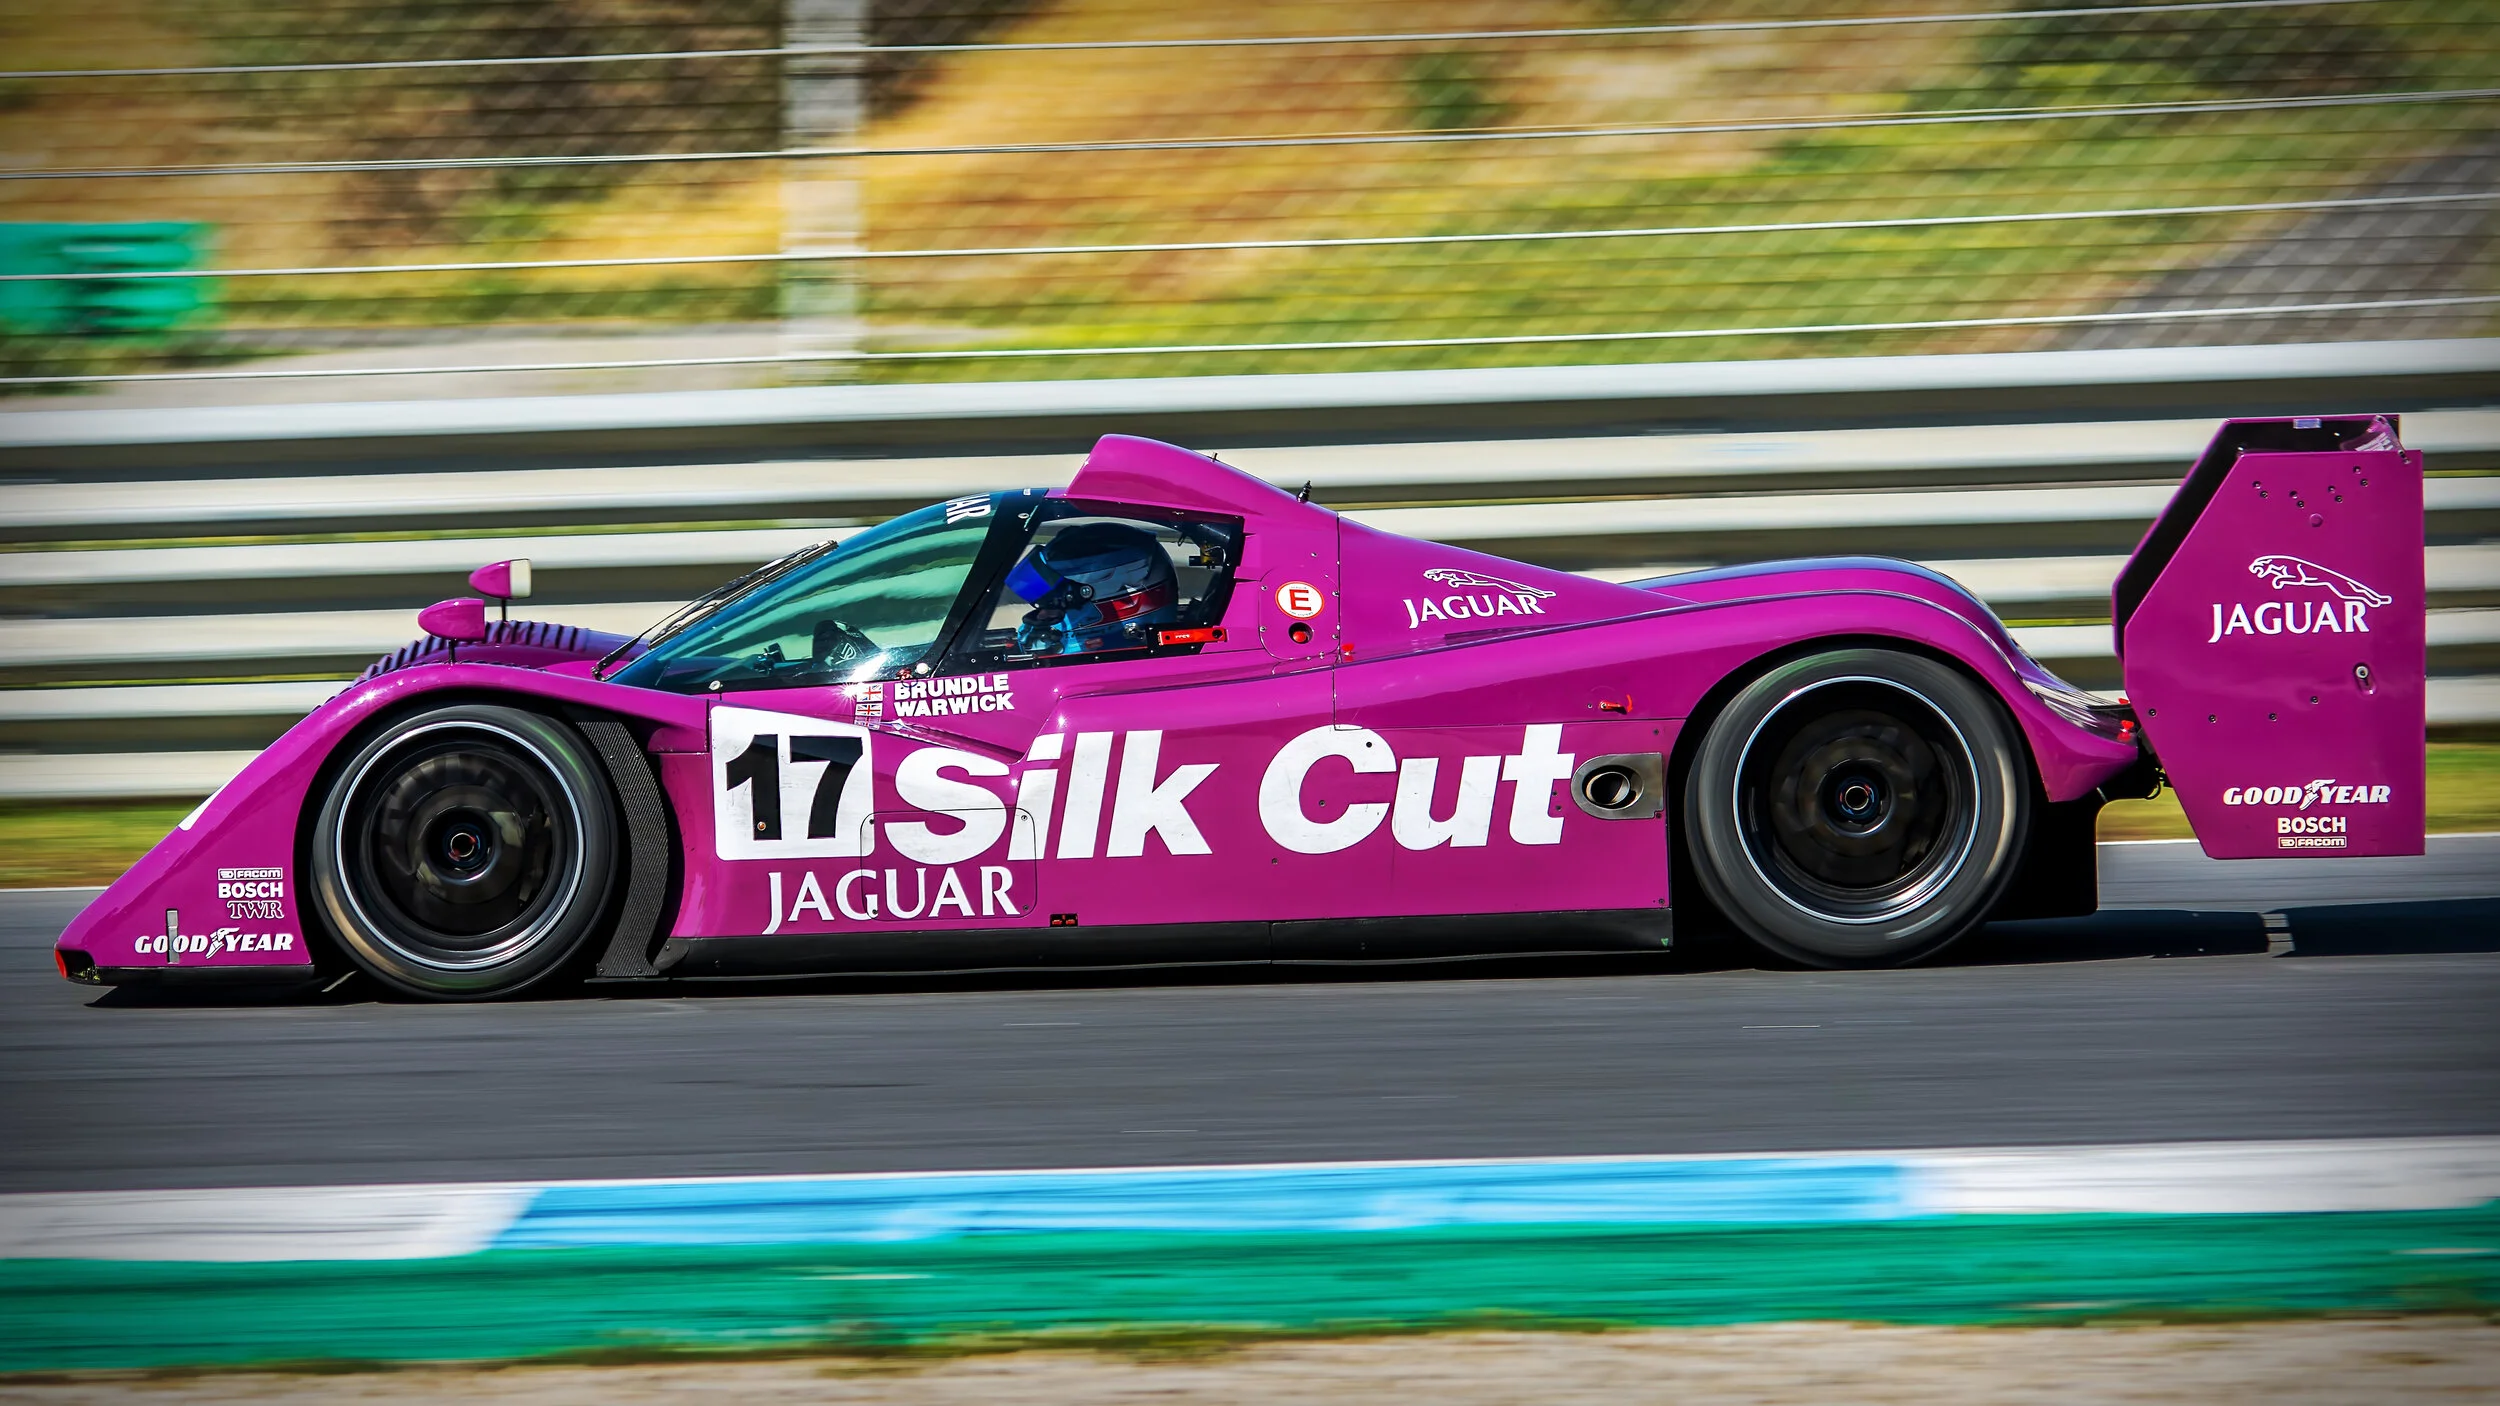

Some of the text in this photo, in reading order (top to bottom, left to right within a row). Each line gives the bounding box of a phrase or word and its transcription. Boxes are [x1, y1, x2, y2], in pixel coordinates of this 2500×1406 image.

[944, 492, 992, 525] AR
[1289, 589, 1312, 611] E
[1402, 594, 1546, 629] JAGUAR
[2207, 600, 2371, 644] JAGUAR
[894, 673, 1010, 701] BRUNDLE
[894, 692, 1015, 717] WARWICK
[725, 733, 864, 841] 17
[884, 724, 1575, 865] Silk Cut
[2277, 816, 2347, 834] BOSCH
[2297, 838, 2345, 847] FACOM
[236, 869, 281, 878] FACOM
[218, 882, 284, 899] BOSCH
[761, 866, 1021, 935] JAGUAR
[226, 900, 285, 919] TWR
